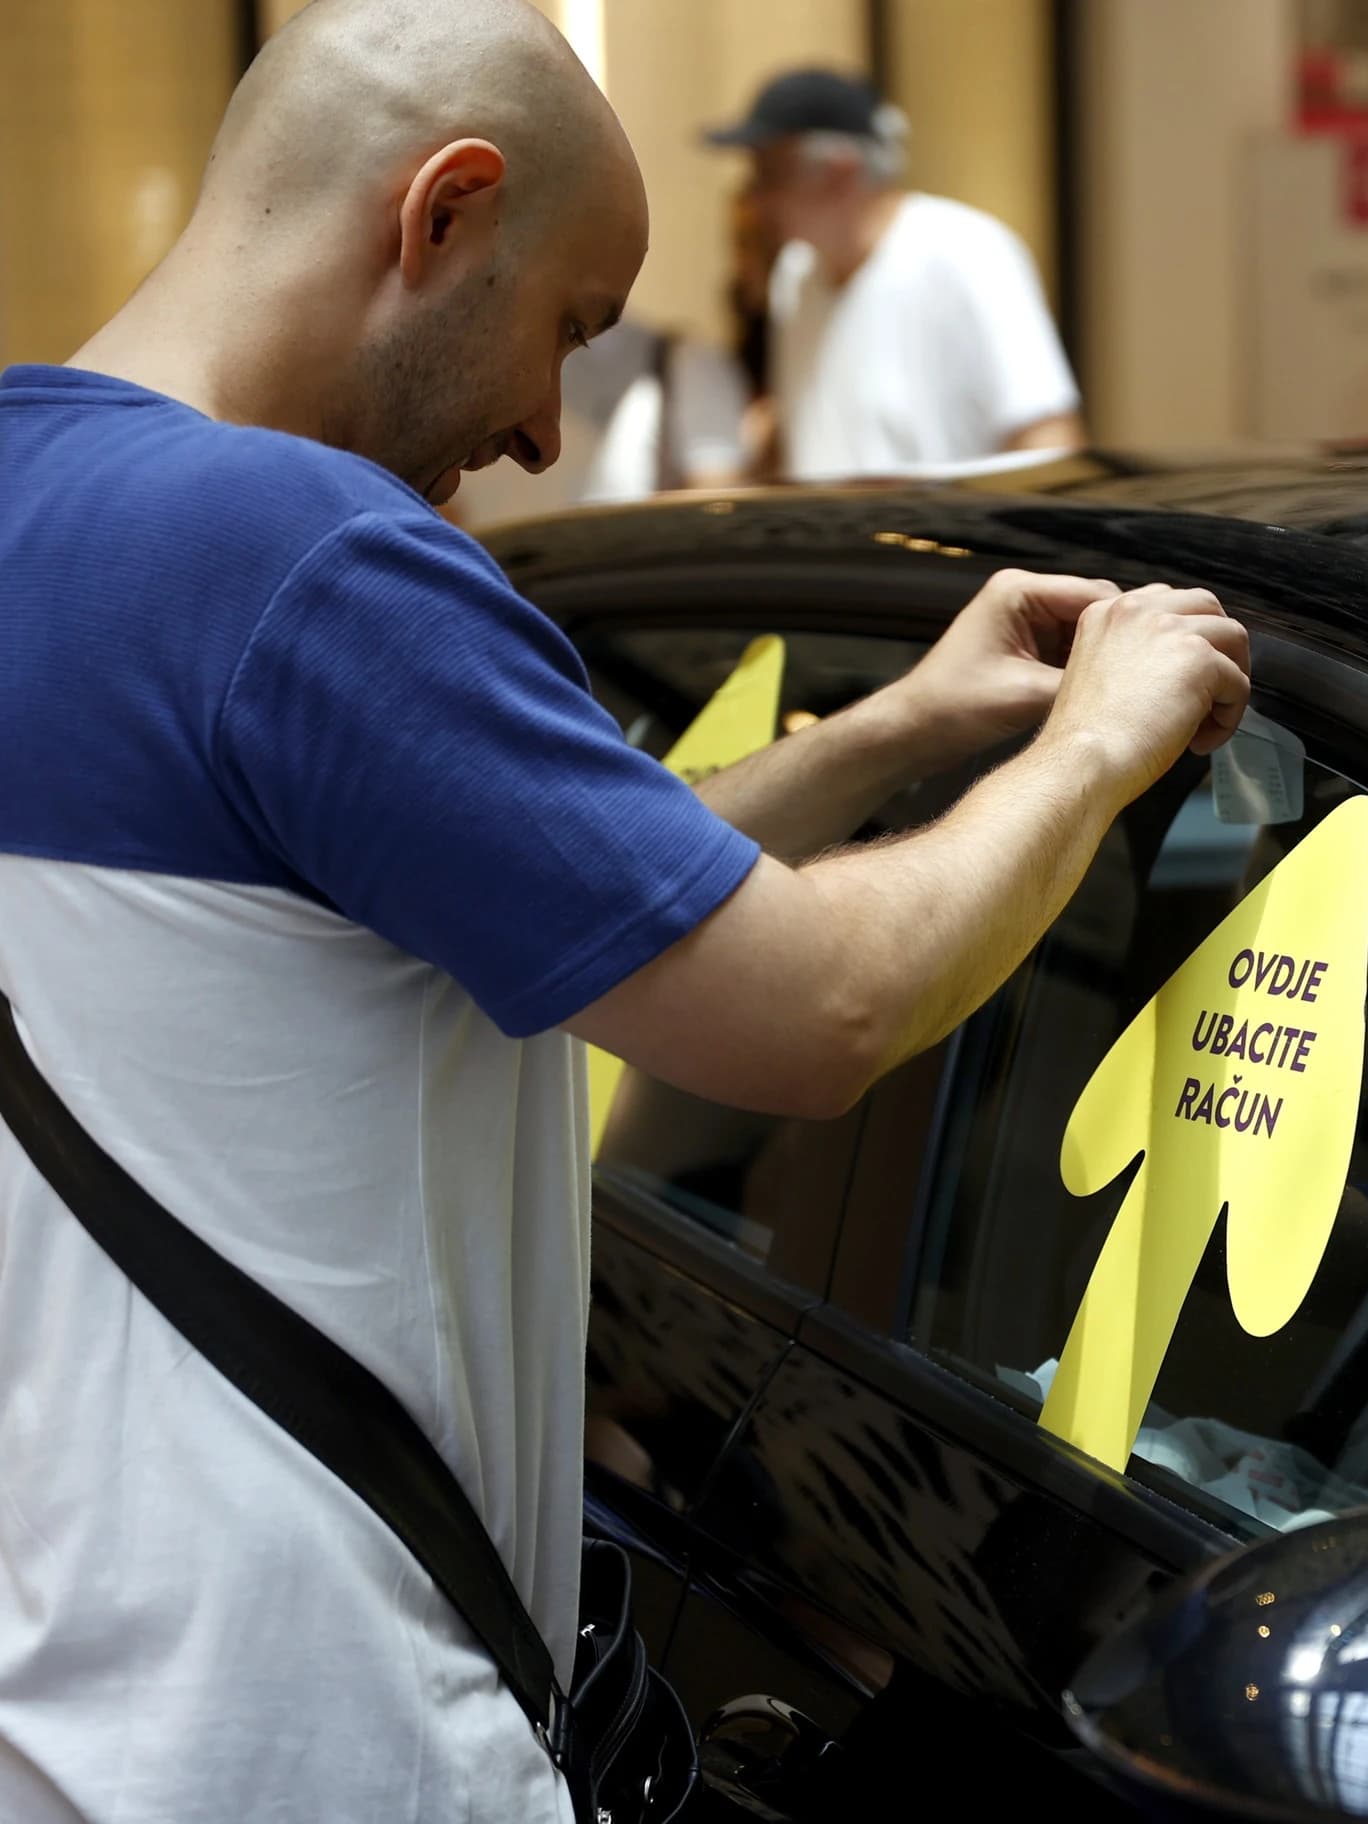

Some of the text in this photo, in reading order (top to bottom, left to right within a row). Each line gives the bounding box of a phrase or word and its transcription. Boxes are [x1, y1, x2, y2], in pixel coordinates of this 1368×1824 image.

[1228, 948, 1328, 1002] OVDJE
[1192, 1010, 1317, 1072] UBACITE
[1174, 1074, 1284, 1139] RAČUN
